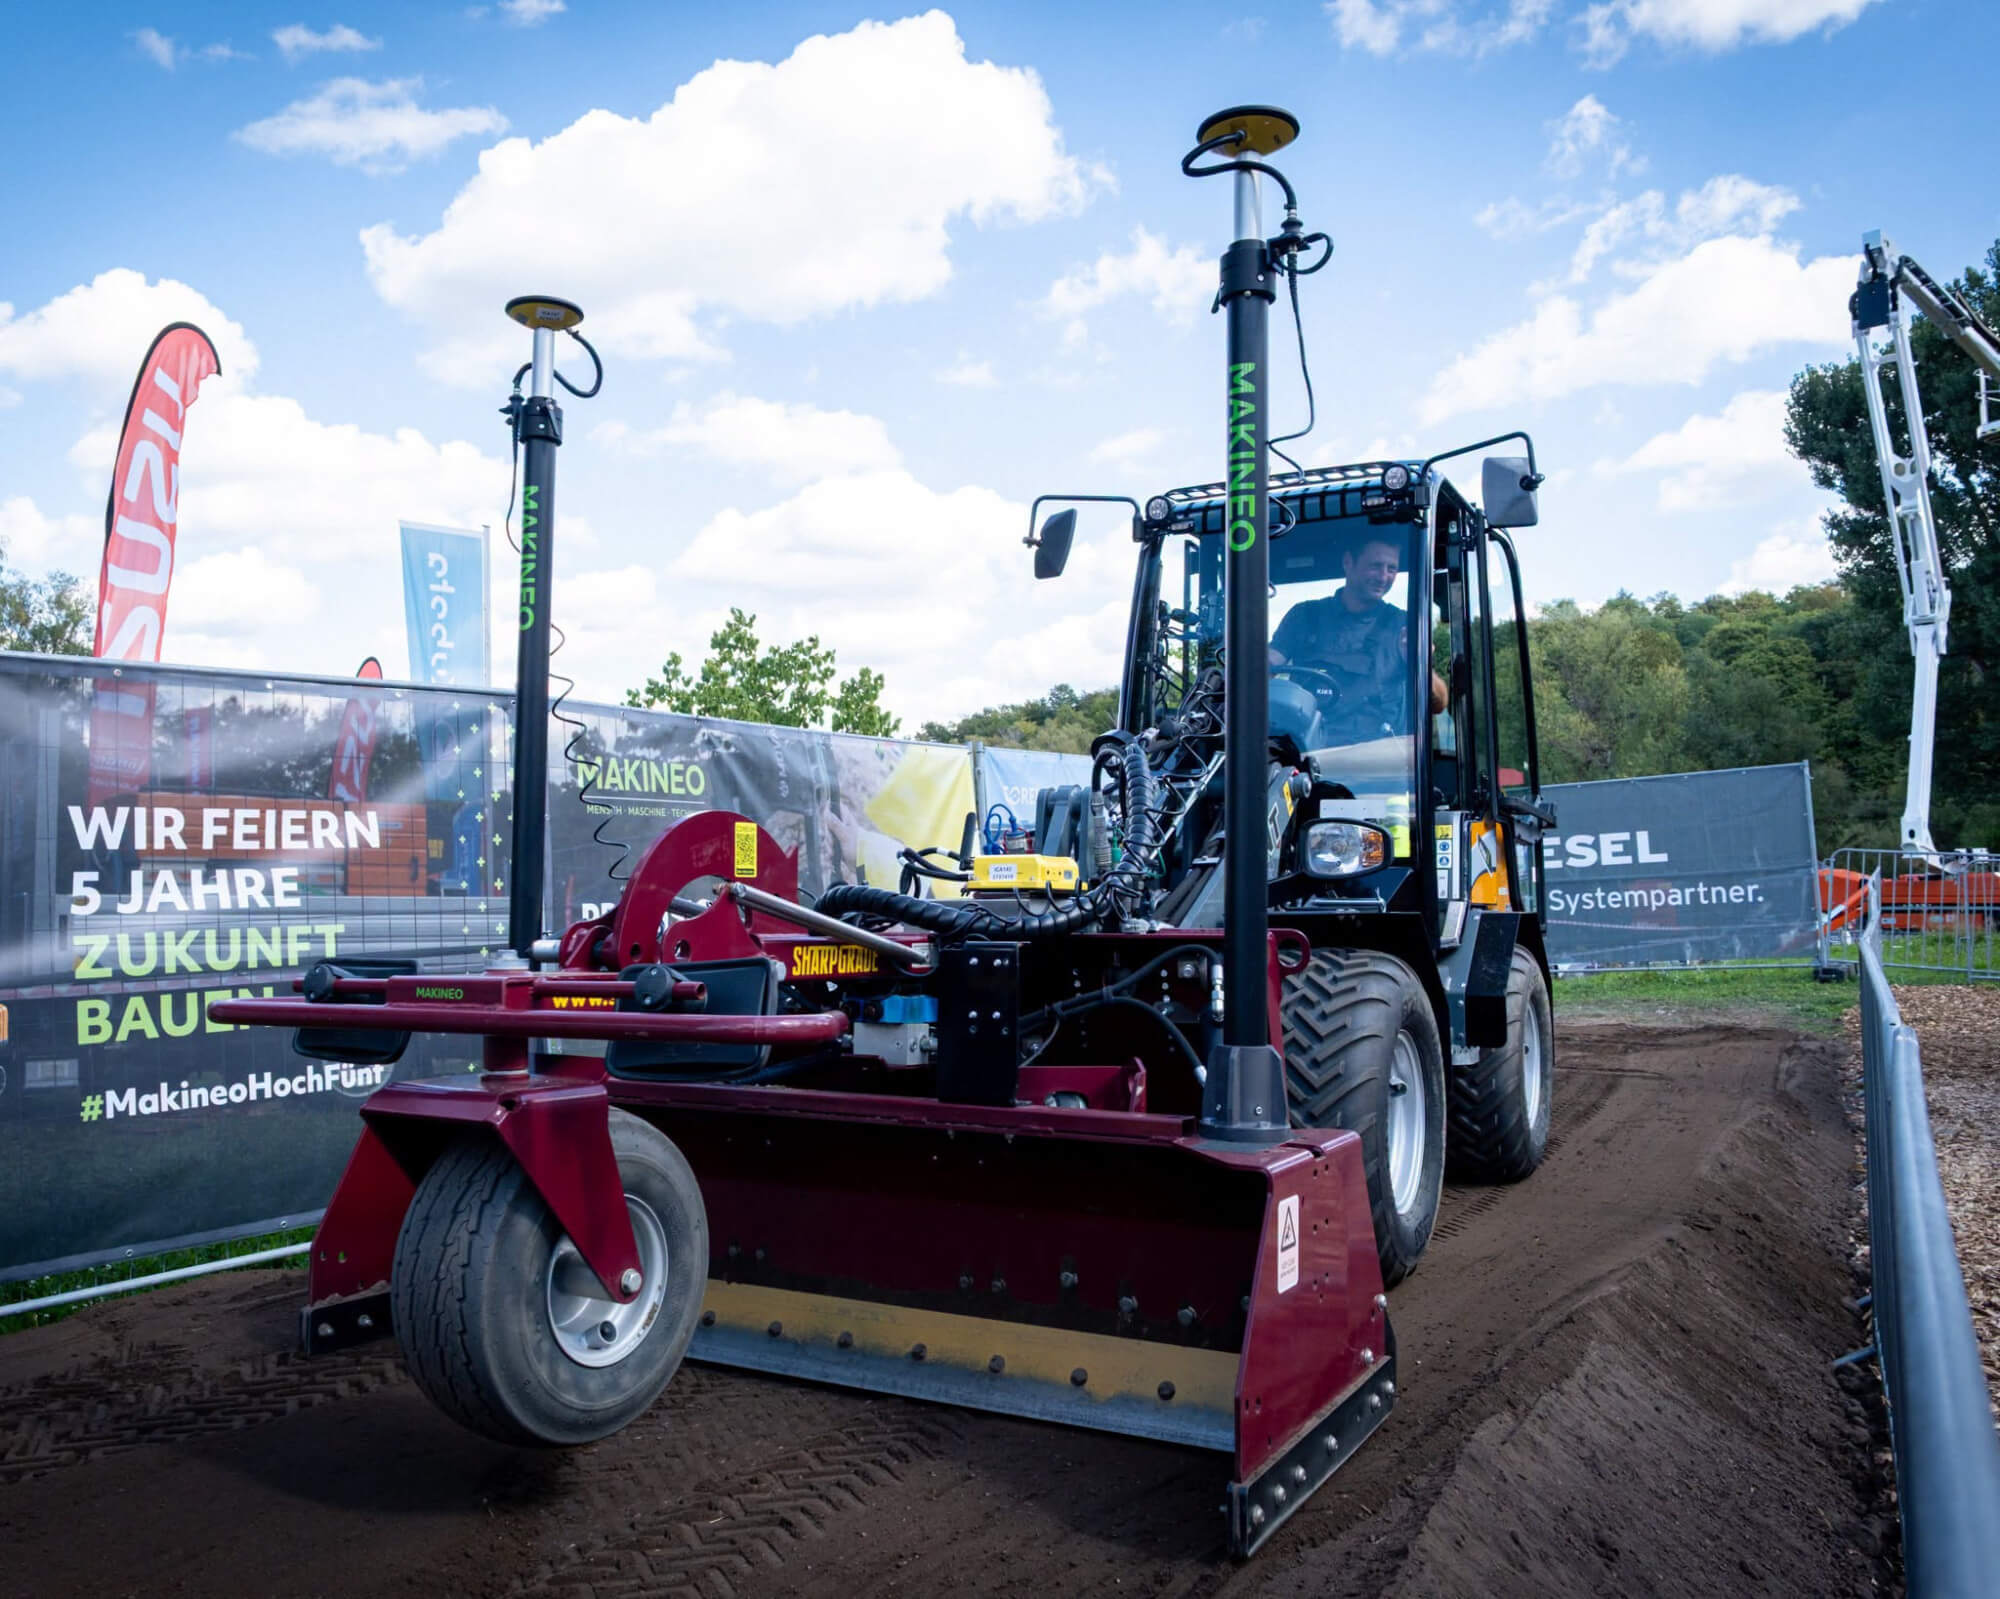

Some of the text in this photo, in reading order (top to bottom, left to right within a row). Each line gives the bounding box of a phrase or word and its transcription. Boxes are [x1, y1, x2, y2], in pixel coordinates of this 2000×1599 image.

[1229, 362, 1256, 552] MAKINEO
[519, 485, 540, 631] MAKINEO
[576, 754, 706, 796] MAKINEO
[67, 805, 381, 850] WIR FEIERN
[628, 806, 667, 817] MASCHINE
[70, 867, 301, 916] 5 JAHRE
[1549, 881, 1764, 915] Systempartner.
[72, 924, 345, 980] ZUKUNFT
[791, 944, 879, 976] SHARPGRADE
[415, 987, 464, 1000] MAKINEO
[80, 1062, 385, 1122] #MakineoHochFünf
